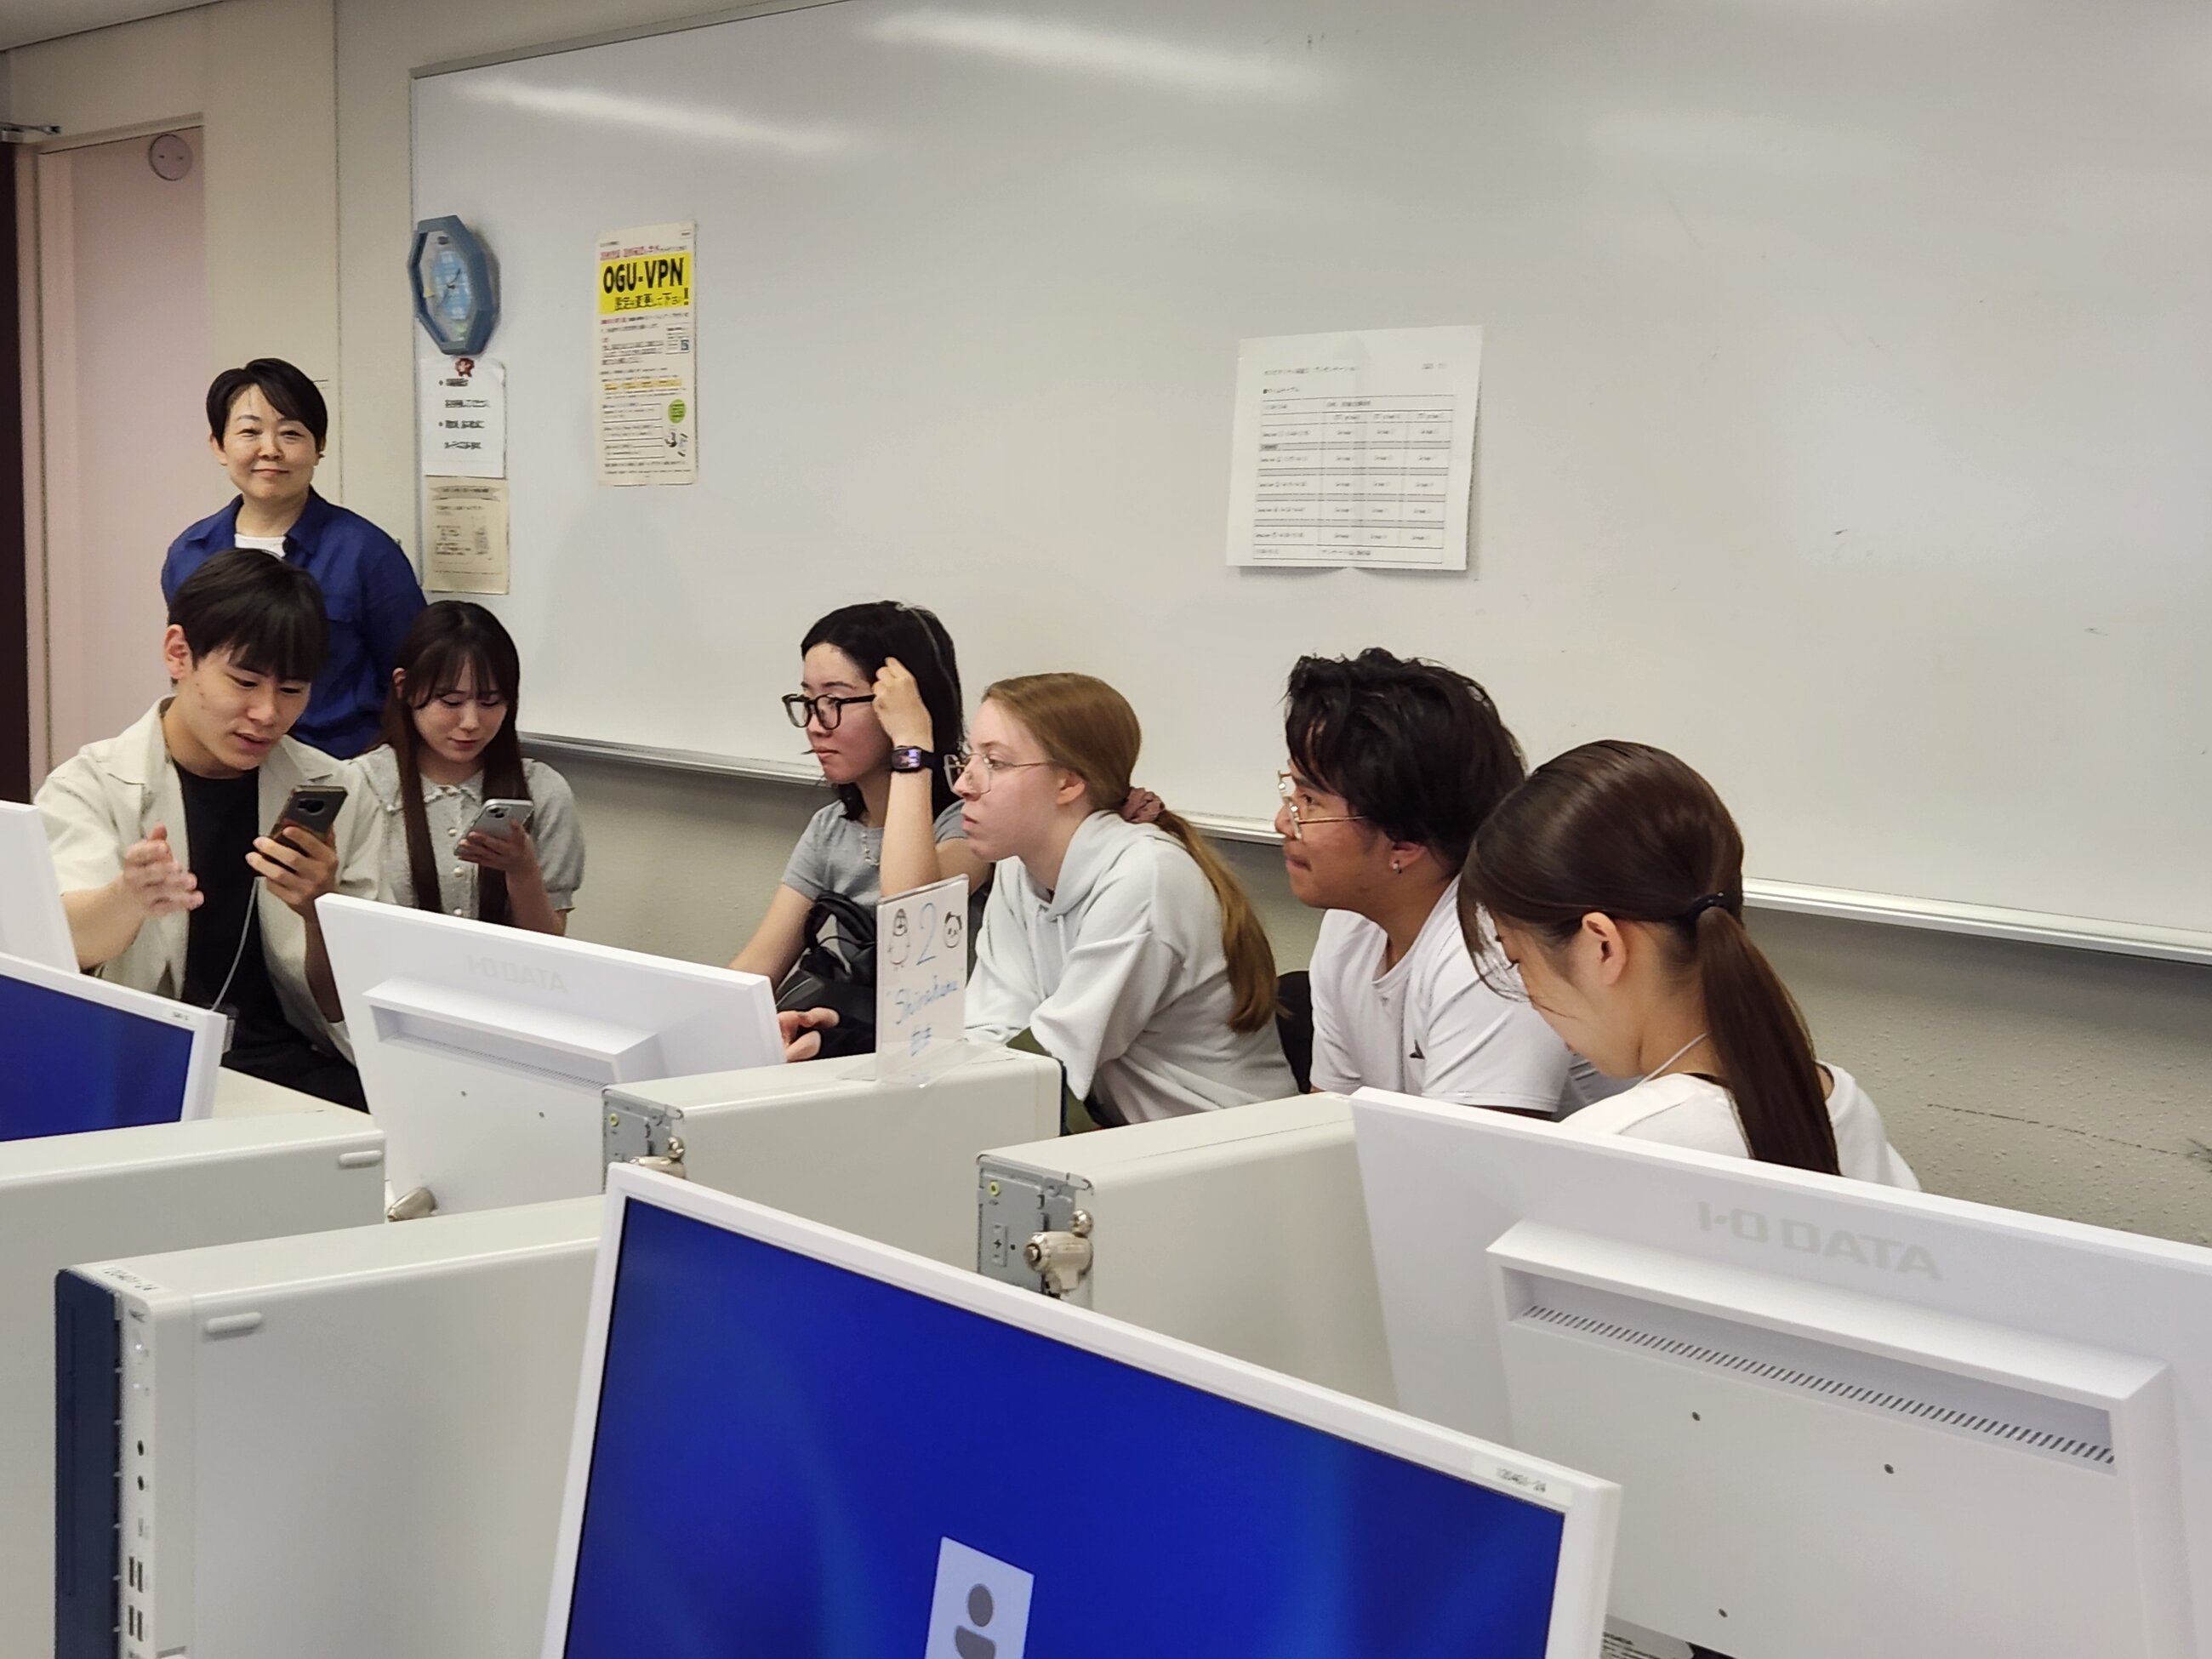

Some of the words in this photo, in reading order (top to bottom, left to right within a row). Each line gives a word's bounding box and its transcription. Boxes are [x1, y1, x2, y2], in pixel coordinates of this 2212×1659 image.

[602, 257, 685, 294] OGU-VPN
[915, 902, 938, 966] 2
[1697, 1200, 1770, 1244] I-O
[1779, 1217, 1945, 1281] DATA
